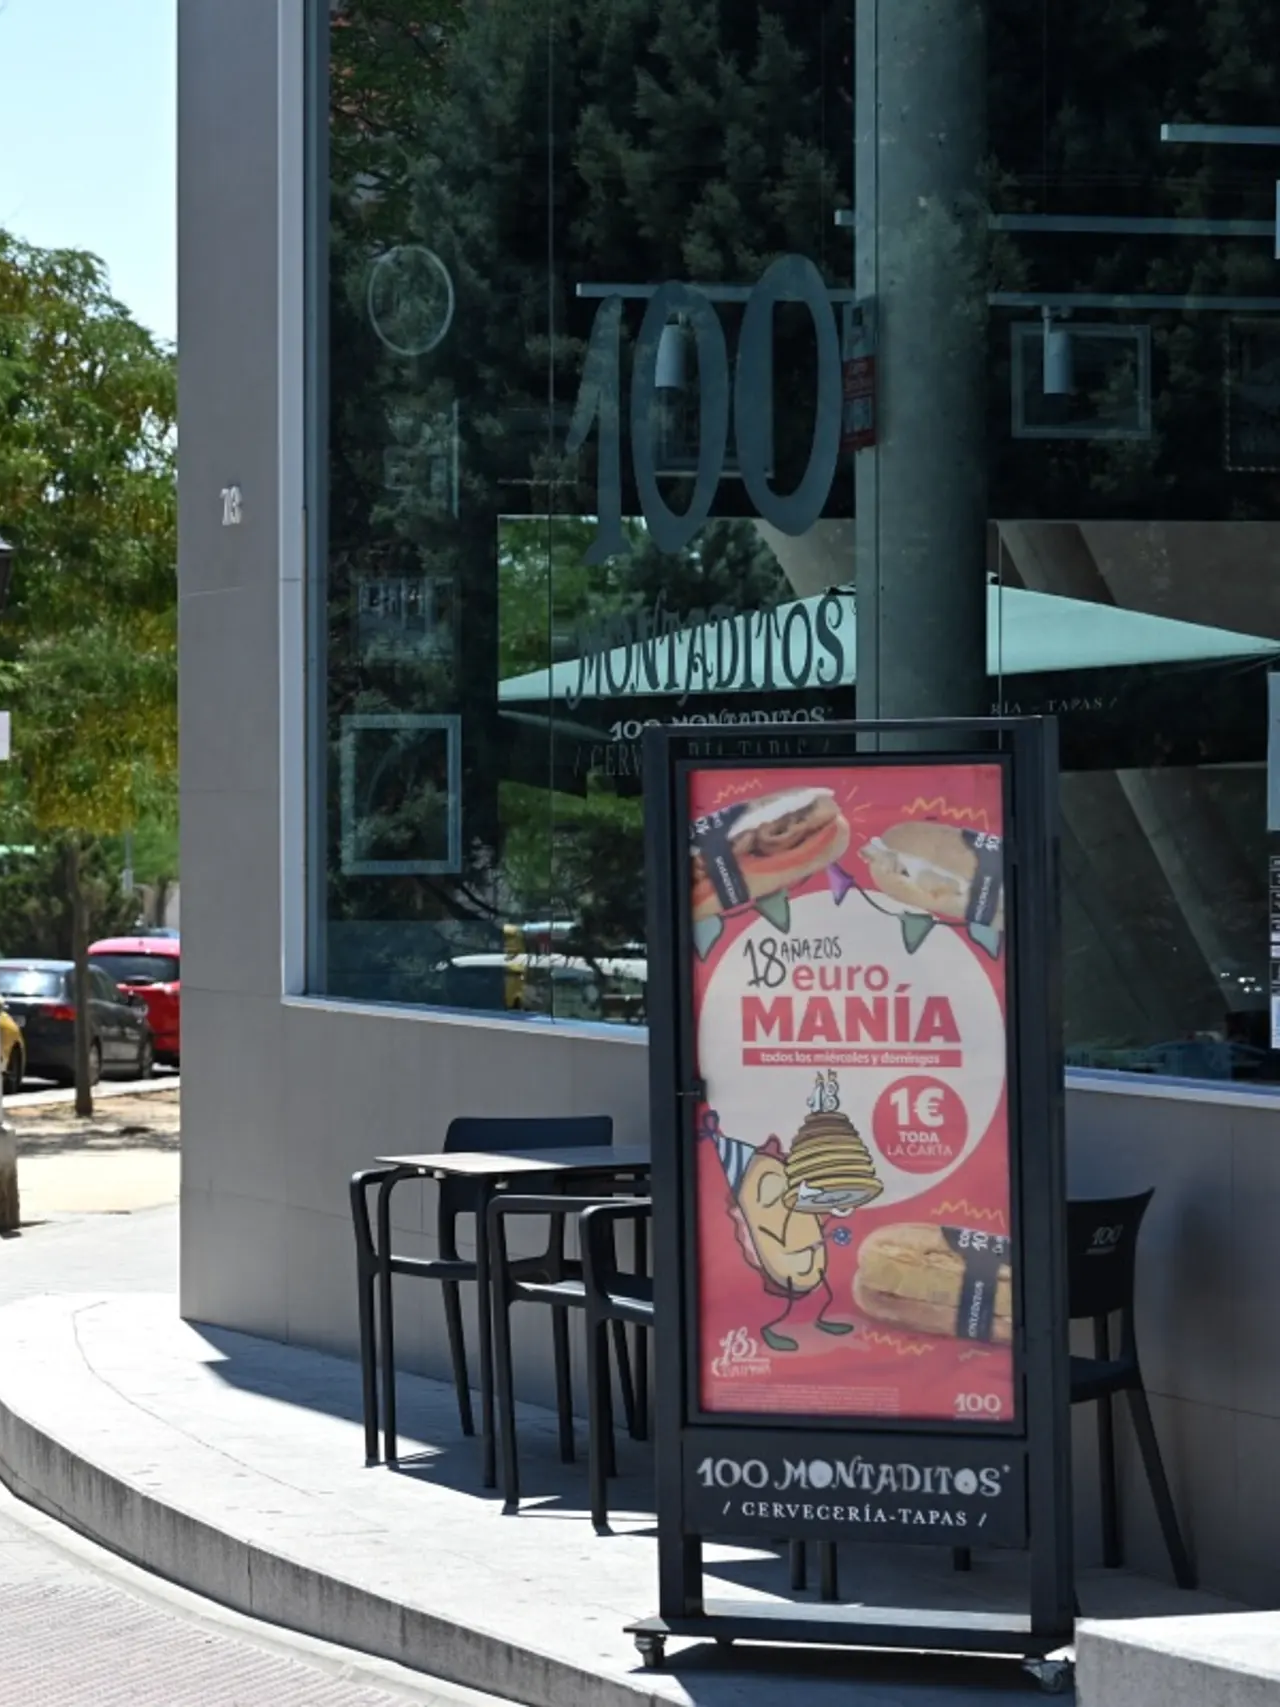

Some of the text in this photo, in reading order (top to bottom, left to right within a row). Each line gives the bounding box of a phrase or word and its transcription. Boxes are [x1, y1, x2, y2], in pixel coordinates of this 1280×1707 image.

[565, 253, 843, 565] 100
[566, 588, 845, 709] MONTADITOS
[743, 936, 842, 988] 18 AÑAZOS
[792, 964, 890, 992] euro
[741, 983, 962, 1043] MANÍA
[761, 1052, 793, 1063] todos
[795, 1052, 812, 1064] los
[814, 1052, 869, 1065] miércoles
[881, 1052, 940, 1067] domingos
[890, 1086, 945, 1128] 1€
[887, 1144, 952, 1157] LA CARTA
[898, 1131, 940, 1144] TODA
[954, 1392, 1002, 1414] 100
[697, 1455, 1002, 1497] 100 MONTADITOS
[741, 1501, 968, 1527] CERVECERÍA-TAPAS
